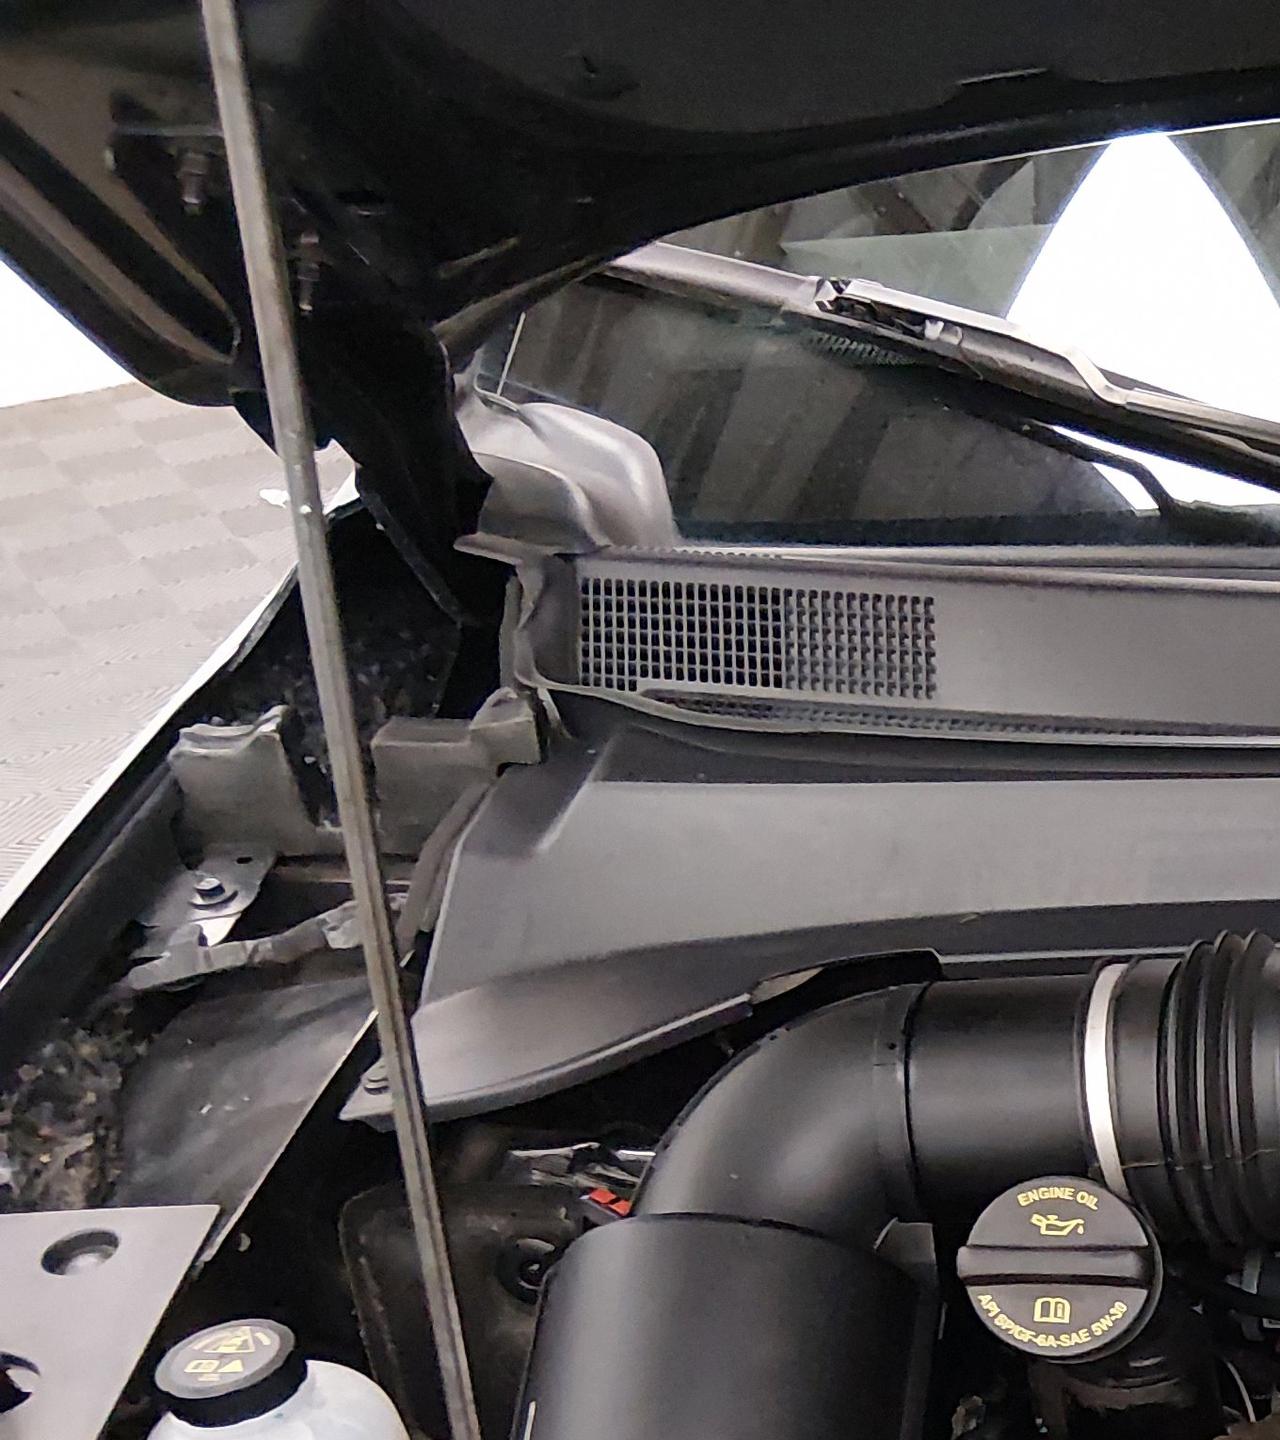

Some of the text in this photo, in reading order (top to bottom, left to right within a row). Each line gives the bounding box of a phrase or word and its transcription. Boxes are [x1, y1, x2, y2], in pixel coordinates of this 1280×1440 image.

[1017, 1186, 1099, 1211] ENGINE OIL
[977, 1294, 1001, 1318] API
[1090, 1301, 1128, 1336] 5W-30
